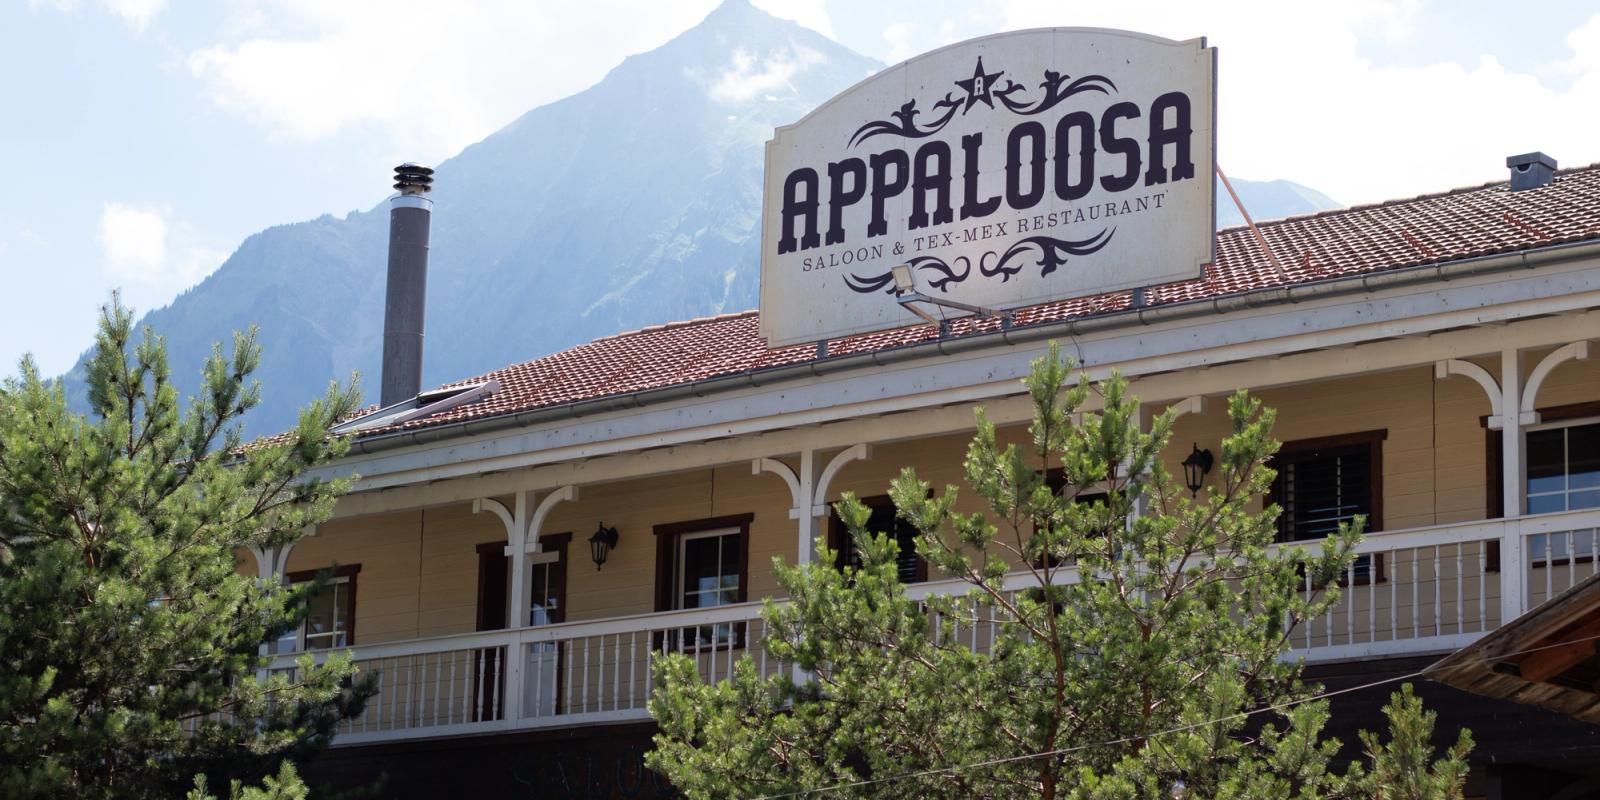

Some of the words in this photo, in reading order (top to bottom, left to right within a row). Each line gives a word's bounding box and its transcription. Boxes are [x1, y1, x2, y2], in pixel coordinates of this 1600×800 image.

[973, 76, 985, 96] A
[778, 91, 1195, 255] APPALOOSA
[802, 244, 884, 272] SALOON
[892, 241, 905, 255] &
[914, 222, 1008, 252] TEX-MEX
[1017, 193, 1165, 233] RESTAURANT
